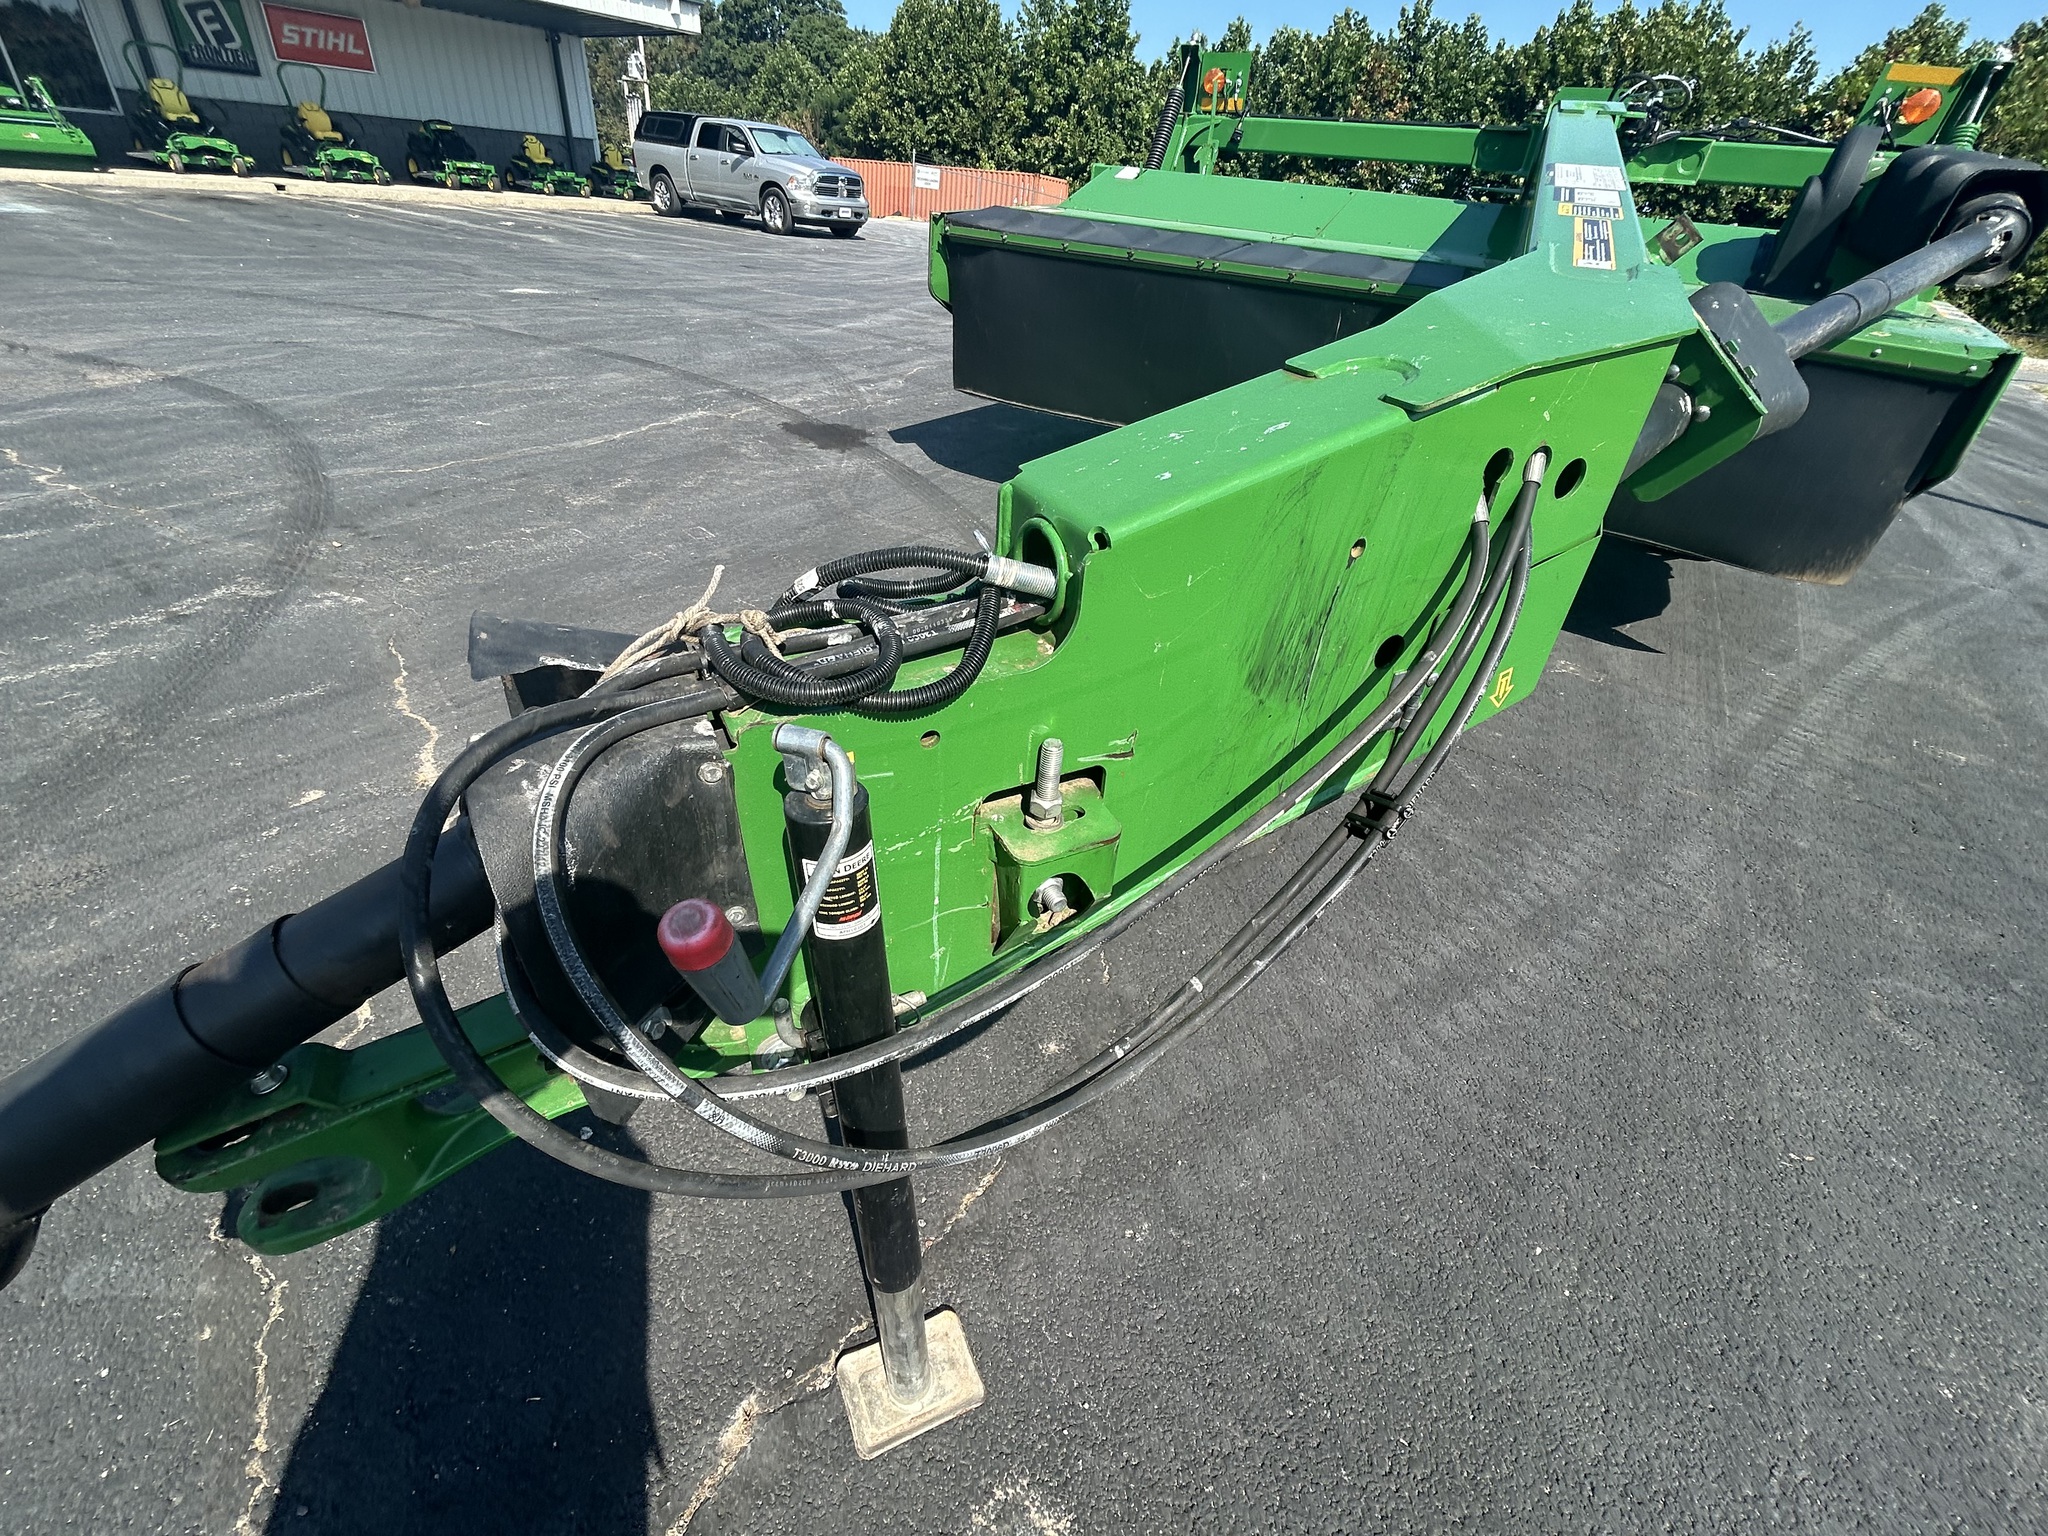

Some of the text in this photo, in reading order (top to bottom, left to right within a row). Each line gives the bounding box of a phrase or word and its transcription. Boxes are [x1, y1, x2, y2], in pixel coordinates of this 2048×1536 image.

[281, 23, 364, 56] STIHL
[190, 44, 254, 70] FRONTIER
[548, 771, 563, 788] PSI
[843, 852, 870, 872] DEERE
[862, 1160, 917, 1173] DIEHARD
